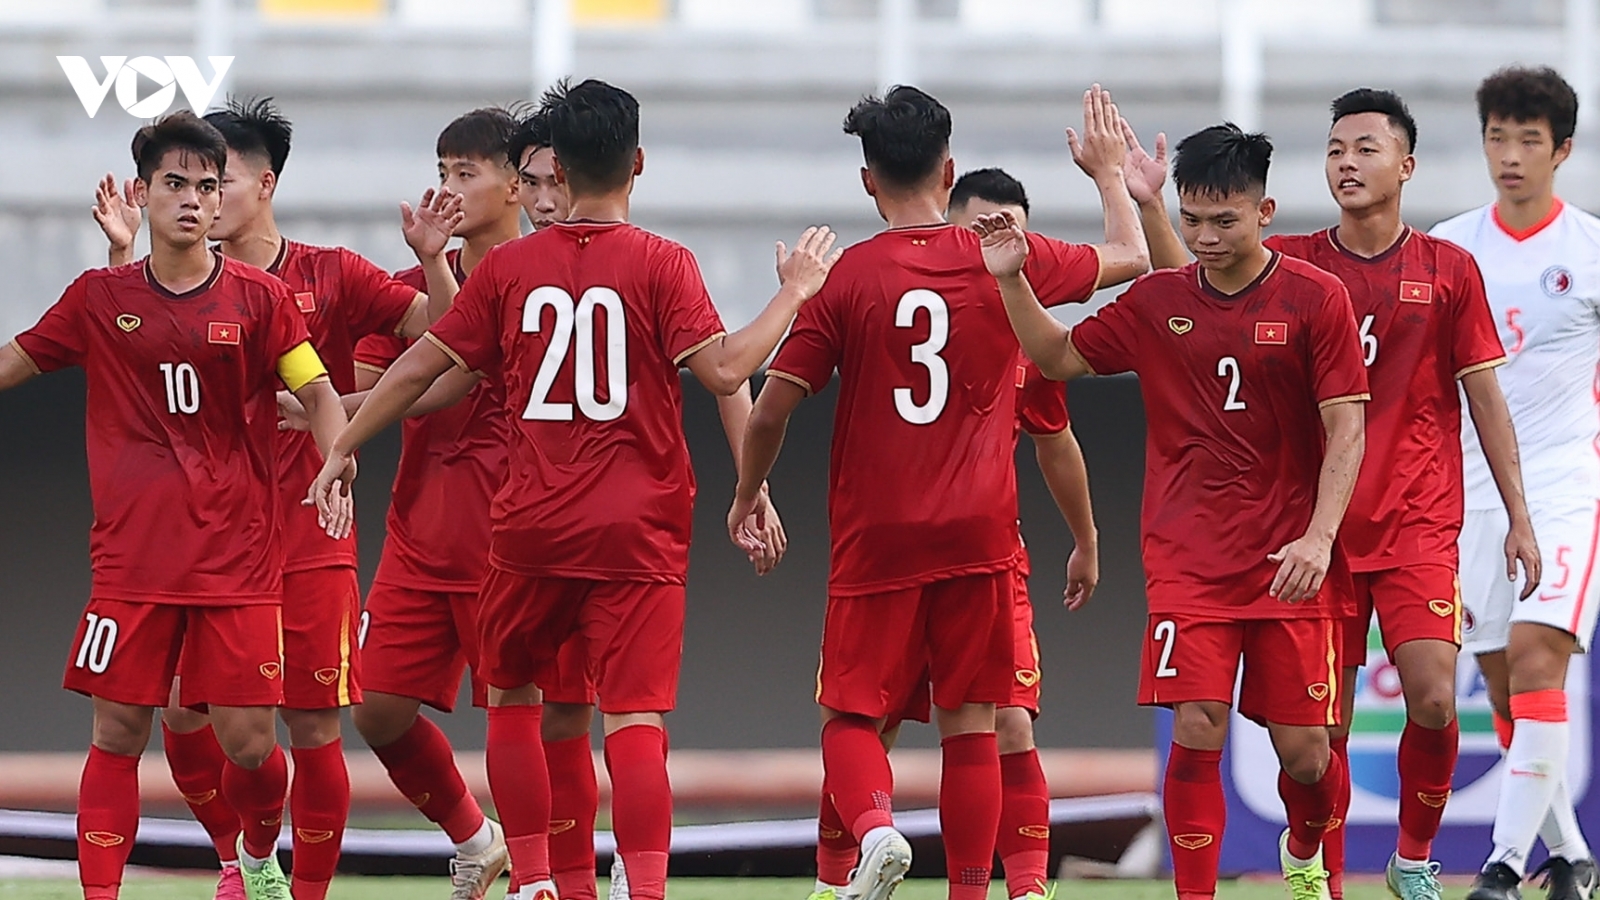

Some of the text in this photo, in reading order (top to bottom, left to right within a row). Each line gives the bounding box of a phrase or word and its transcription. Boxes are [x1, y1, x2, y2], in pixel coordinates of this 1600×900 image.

[521, 286, 628, 421] 20
[893, 289, 950, 425] 3
[1505, 307, 1525, 354] 5
[158, 362, 200, 414] 10
[1217, 356, 1246, 411] 2
[1551, 545, 1571, 590] 5
[75, 612, 118, 674] 10
[1153, 620, 1178, 678] 2
